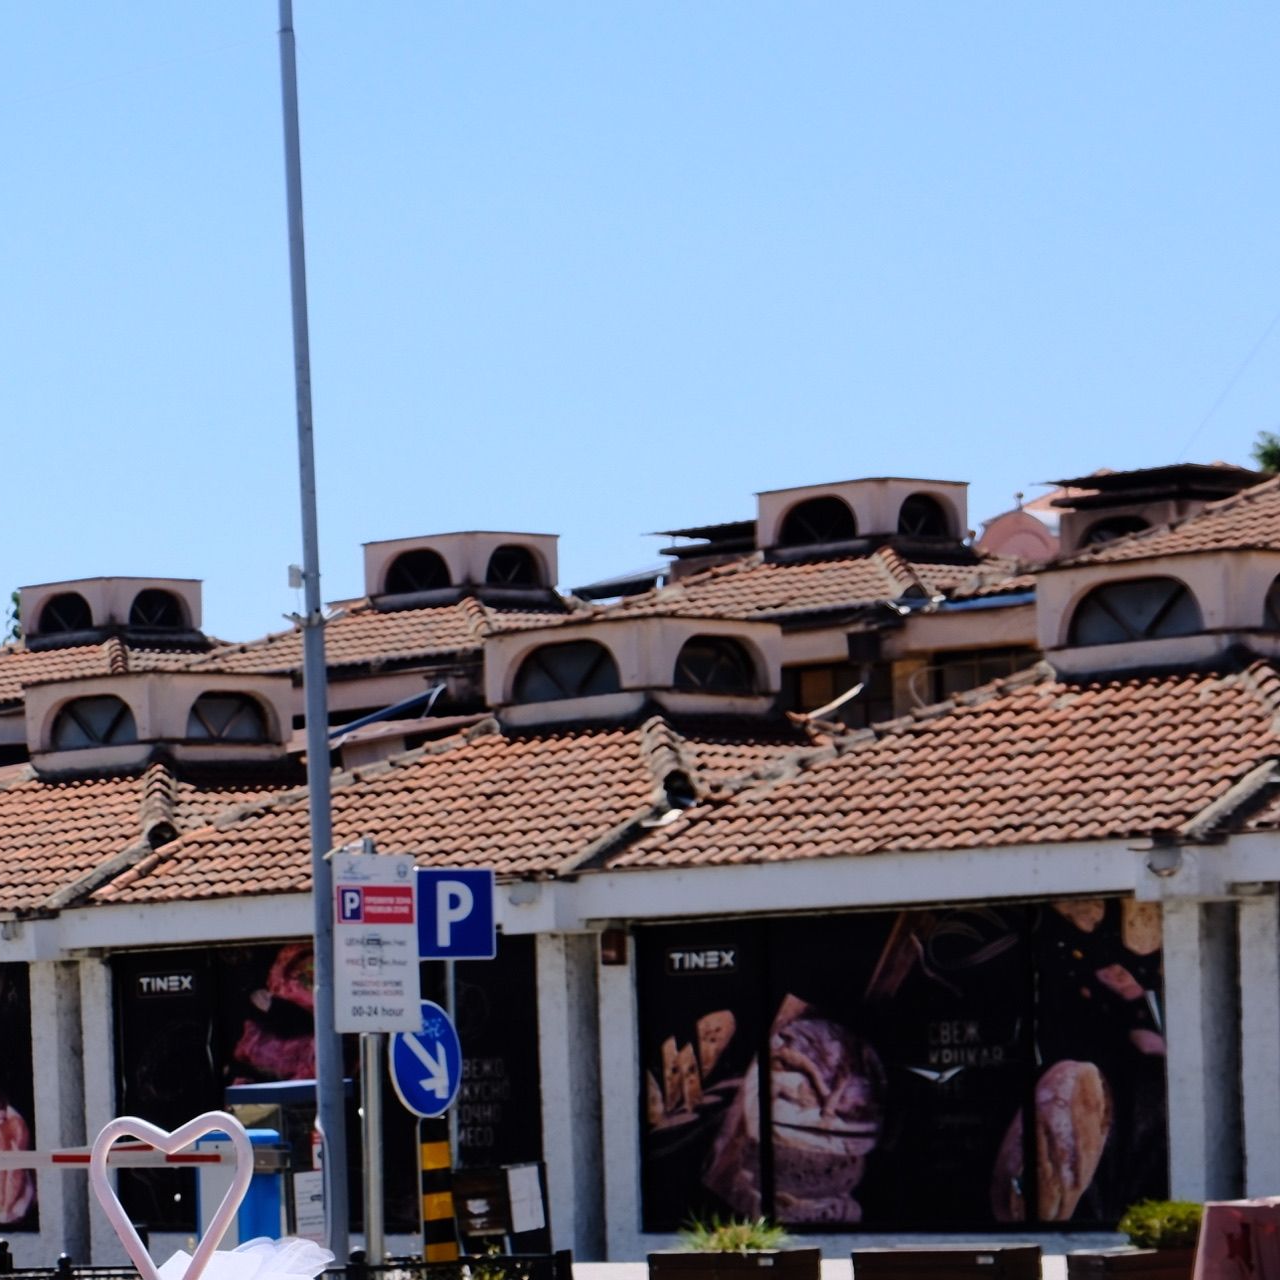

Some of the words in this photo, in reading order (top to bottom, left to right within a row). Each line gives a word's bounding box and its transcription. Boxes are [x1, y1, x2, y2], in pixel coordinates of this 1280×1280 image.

[344, 892, 360, 918] P
[436, 880, 474, 947] P
[669, 950, 735, 970] TINEX
[139, 975, 192, 992] TINEX
[352, 1006, 378, 1017] 00-24
[382, 1006, 405, 1017] hour
[462, 1058, 505, 1079] ВЕЖО
[459, 1074, 511, 1101] КУСНО
[461, 1104, 503, 1124] ОЧНО
